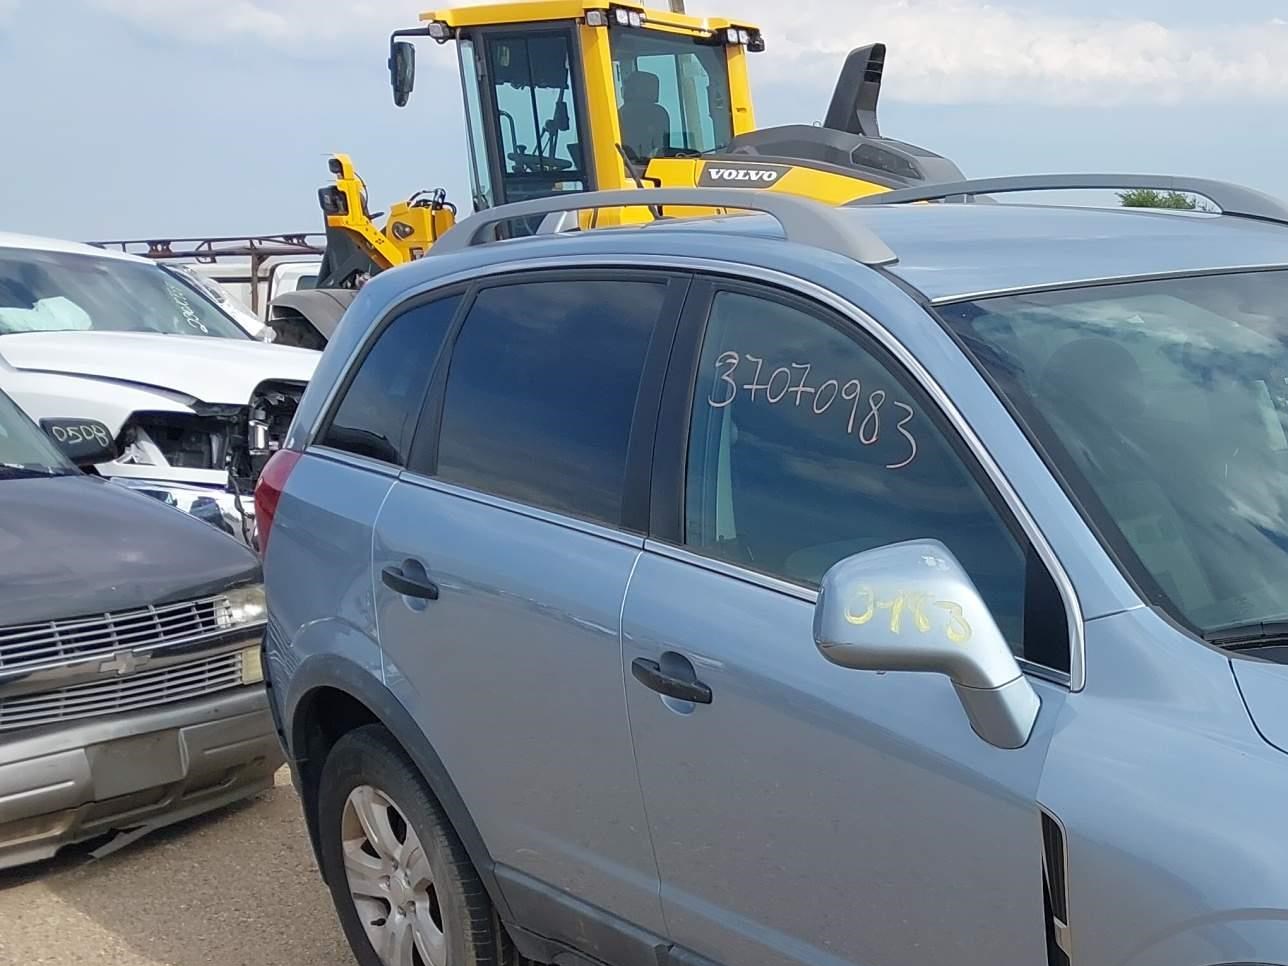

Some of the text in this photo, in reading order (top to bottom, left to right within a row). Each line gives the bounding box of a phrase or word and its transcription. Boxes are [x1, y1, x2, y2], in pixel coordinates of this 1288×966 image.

[707, 168, 778, 182] VOLVO
[708, 351, 917, 469] 37070983
[52, 424, 109, 447] 0508
